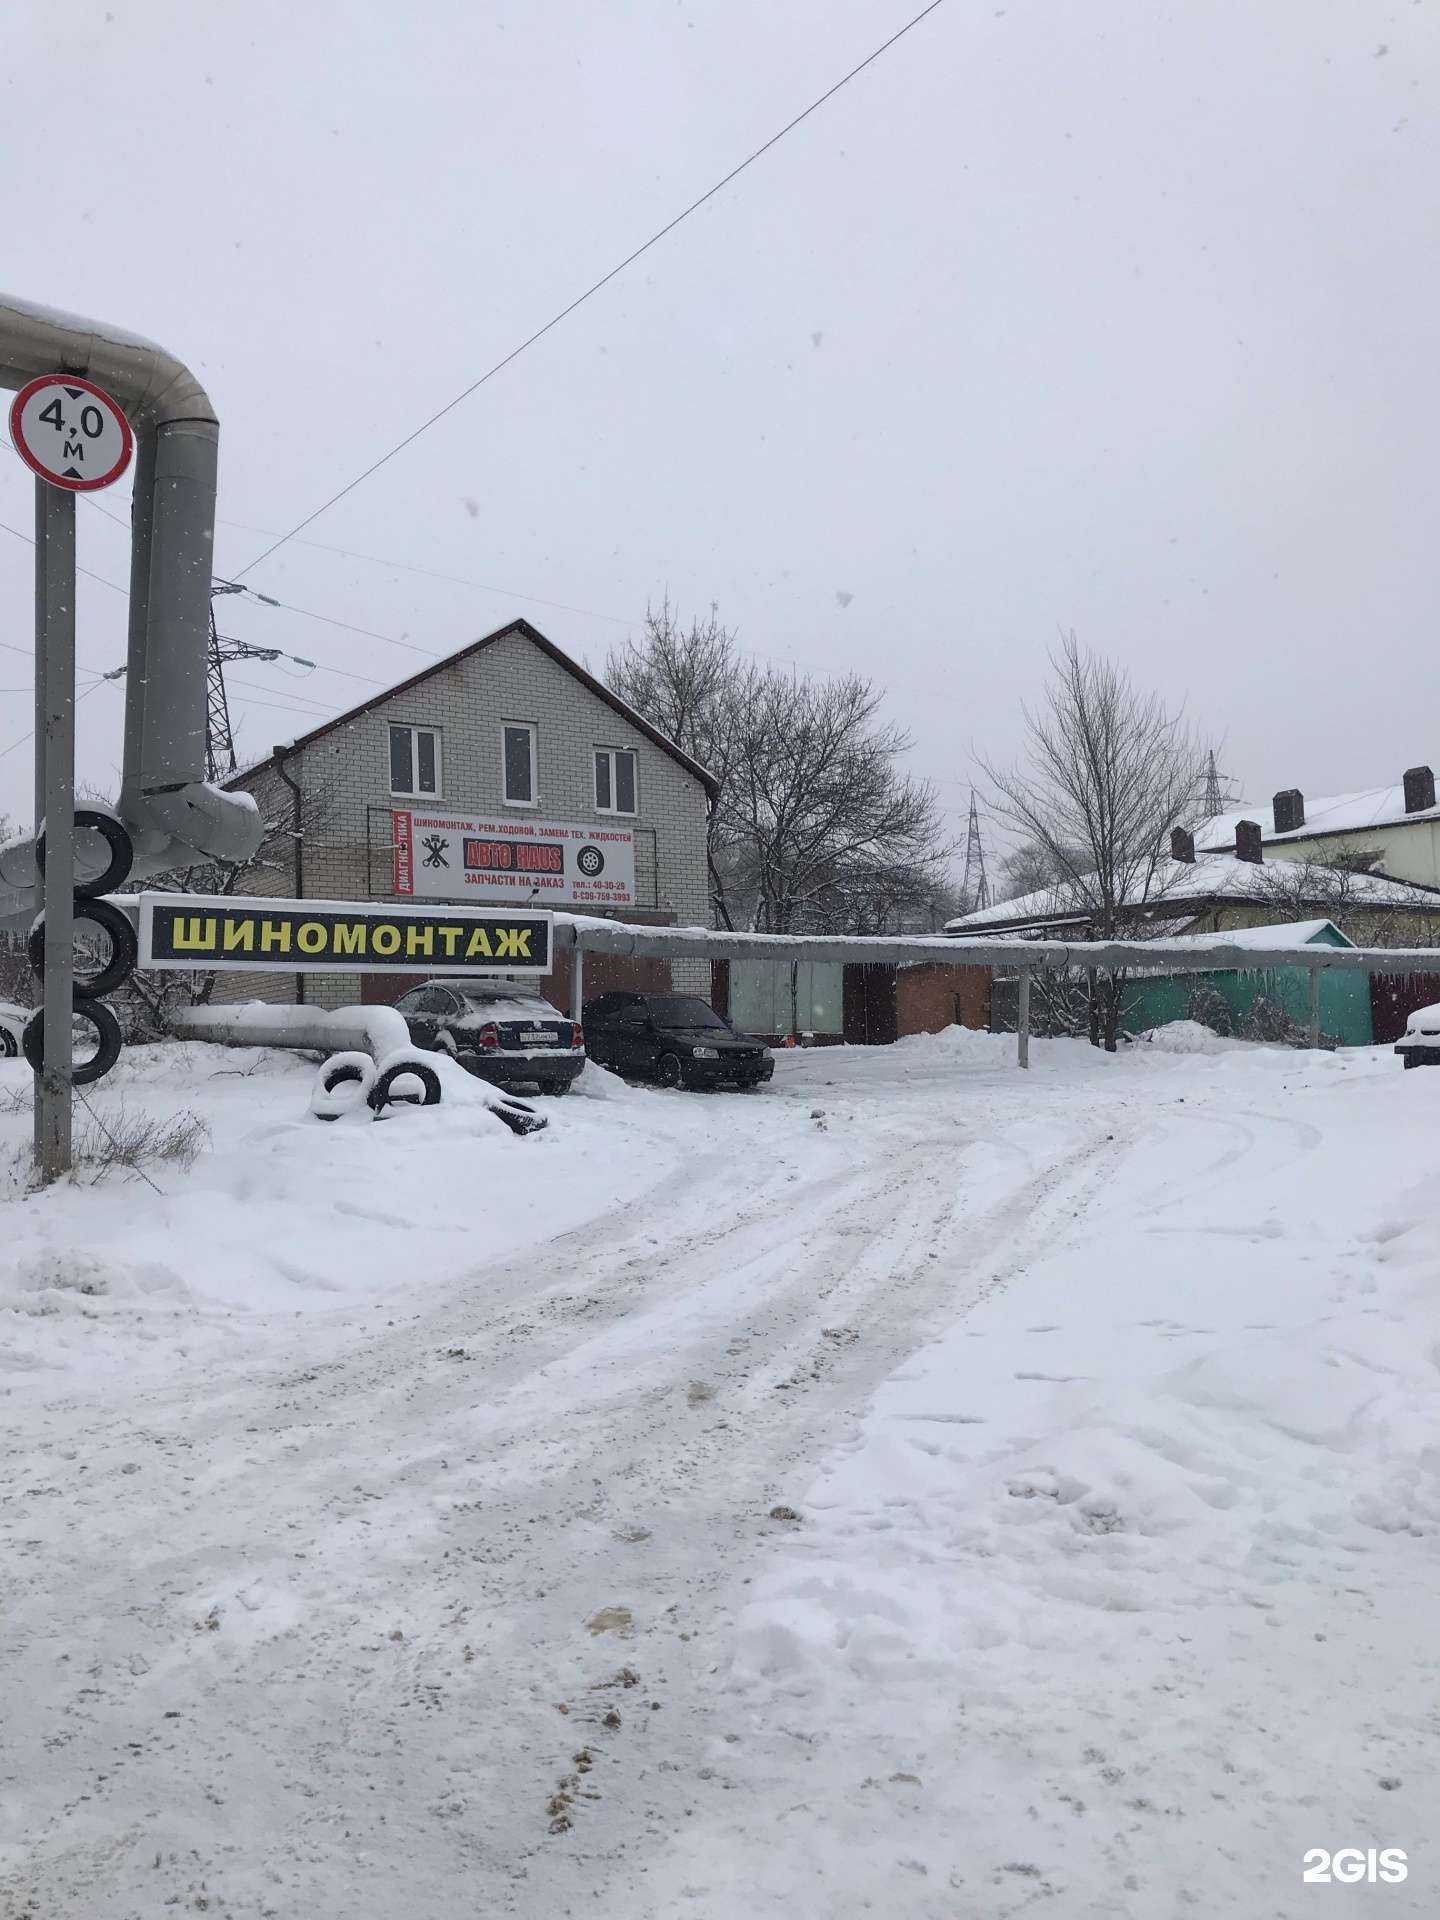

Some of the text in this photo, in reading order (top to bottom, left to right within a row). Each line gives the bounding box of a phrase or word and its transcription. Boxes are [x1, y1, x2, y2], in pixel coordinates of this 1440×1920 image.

[38, 398, 104, 439] 4,0
[414, 817, 476, 832] ШИНОМОНТАЖ,
[539, 827, 569, 838] ЗАМЕНА
[571, 830, 586, 840] ТЕХ.
[588, 831, 632, 843] ЖИДКОСТЕЙ
[397, 815, 411, 892] ДИАГНОСТИКА
[467, 841, 562, 871] АВТО HAUS
[464, 872, 565, 889] ЗАПЧАСТИ НА ЗАКАЗ
[172, 917, 533, 957] ШИНОМОНТАЖ
